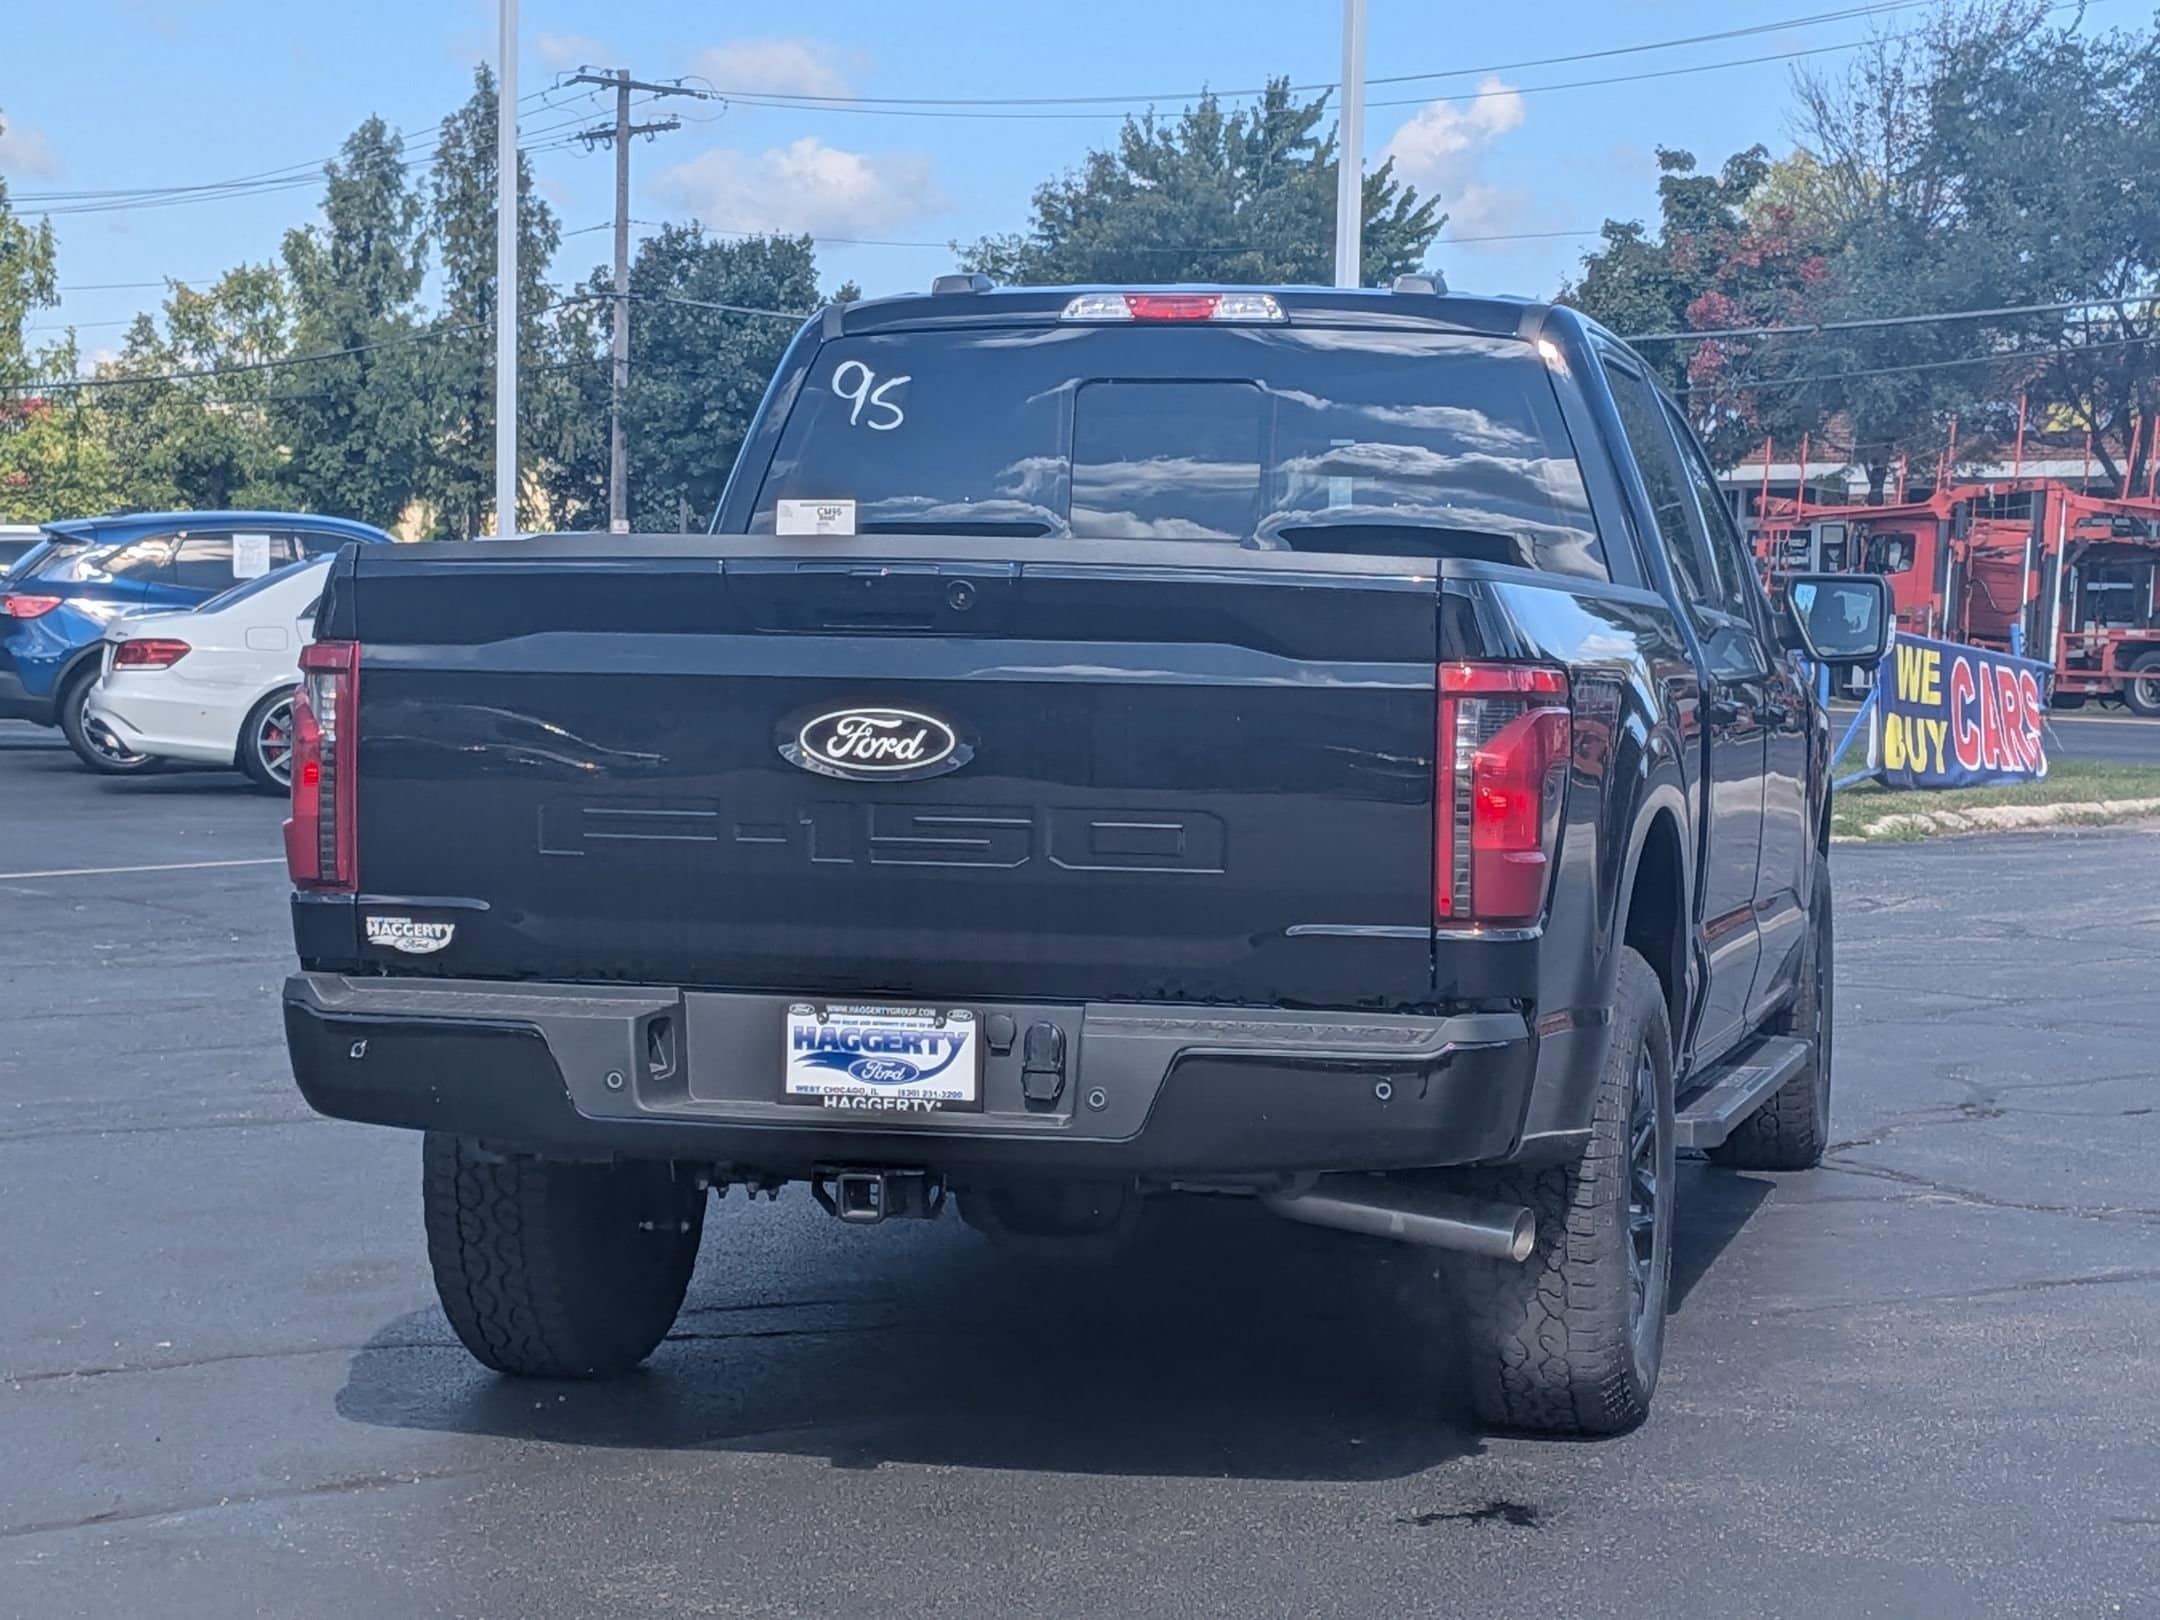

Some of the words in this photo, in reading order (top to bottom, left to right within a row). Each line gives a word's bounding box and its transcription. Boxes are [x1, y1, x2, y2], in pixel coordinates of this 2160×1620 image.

[832, 360, 911, 430] 95
[1896, 644, 1942, 705] WE
[826, 716, 928, 759] Ford
[1951, 656, 2048, 777] CARS
[1885, 712, 1948, 774] BUY
[366, 919, 456, 938] HAGGERTY
[793, 1025, 969, 1056] HAGGERTY
[796, 1085, 820, 1093] WEST
[861, 1061, 905, 1081] Ford
